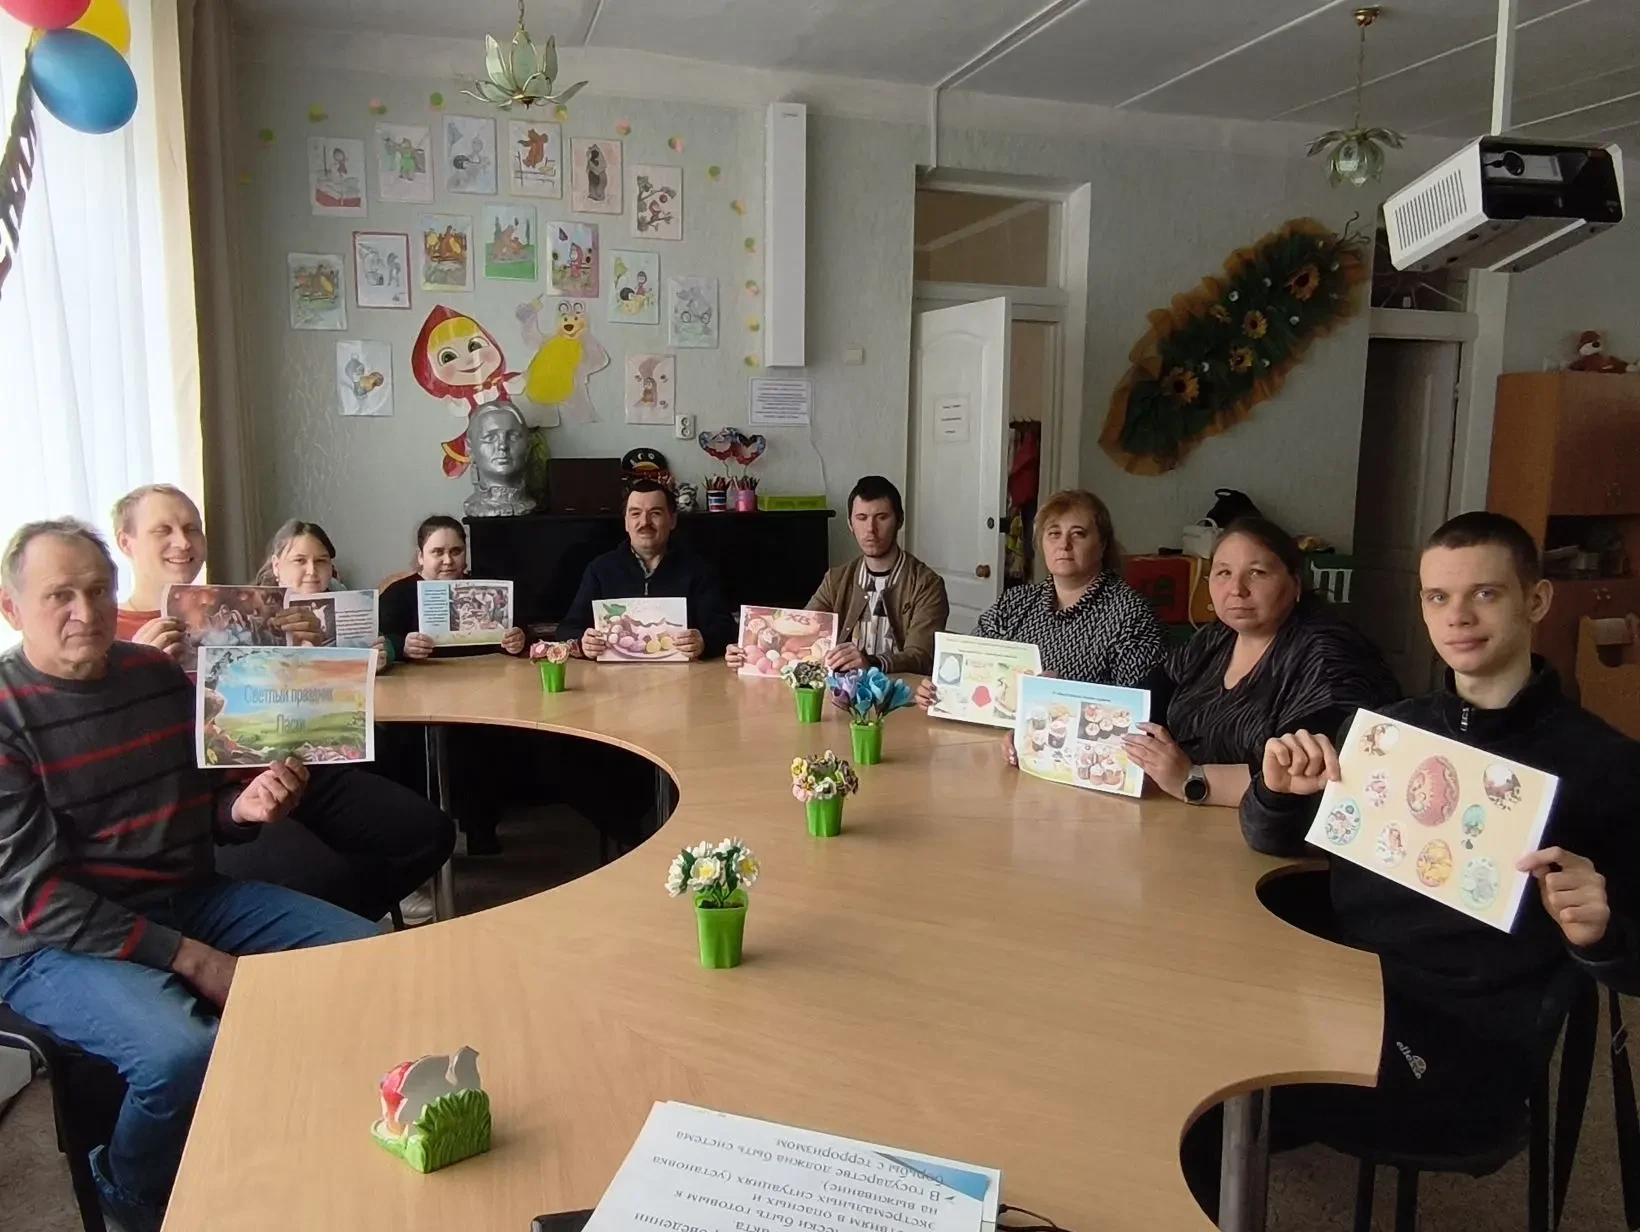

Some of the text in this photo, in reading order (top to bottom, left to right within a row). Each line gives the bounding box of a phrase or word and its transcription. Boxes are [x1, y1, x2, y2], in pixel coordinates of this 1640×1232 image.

[244, 684, 334, 708] Светлый праздник
[676, 1130, 940, 1202] В государстве должна быть система
[876, 1161, 885, 1170] с
[888, 1163, 944, 1187] борьбы
[652, 1155, 936, 1231] экстремальных ситуациях (установка
[674, 1190, 683, 1198] к
[686, 1192, 751, 1215] готовым
[752, 1193, 762, 1203] и
[756, 1209, 794, 1228] быть
[767, 1196, 832, 1220] опасных
[837, 1213, 846, 1223] в
[920, 1204, 938, 1216] на
